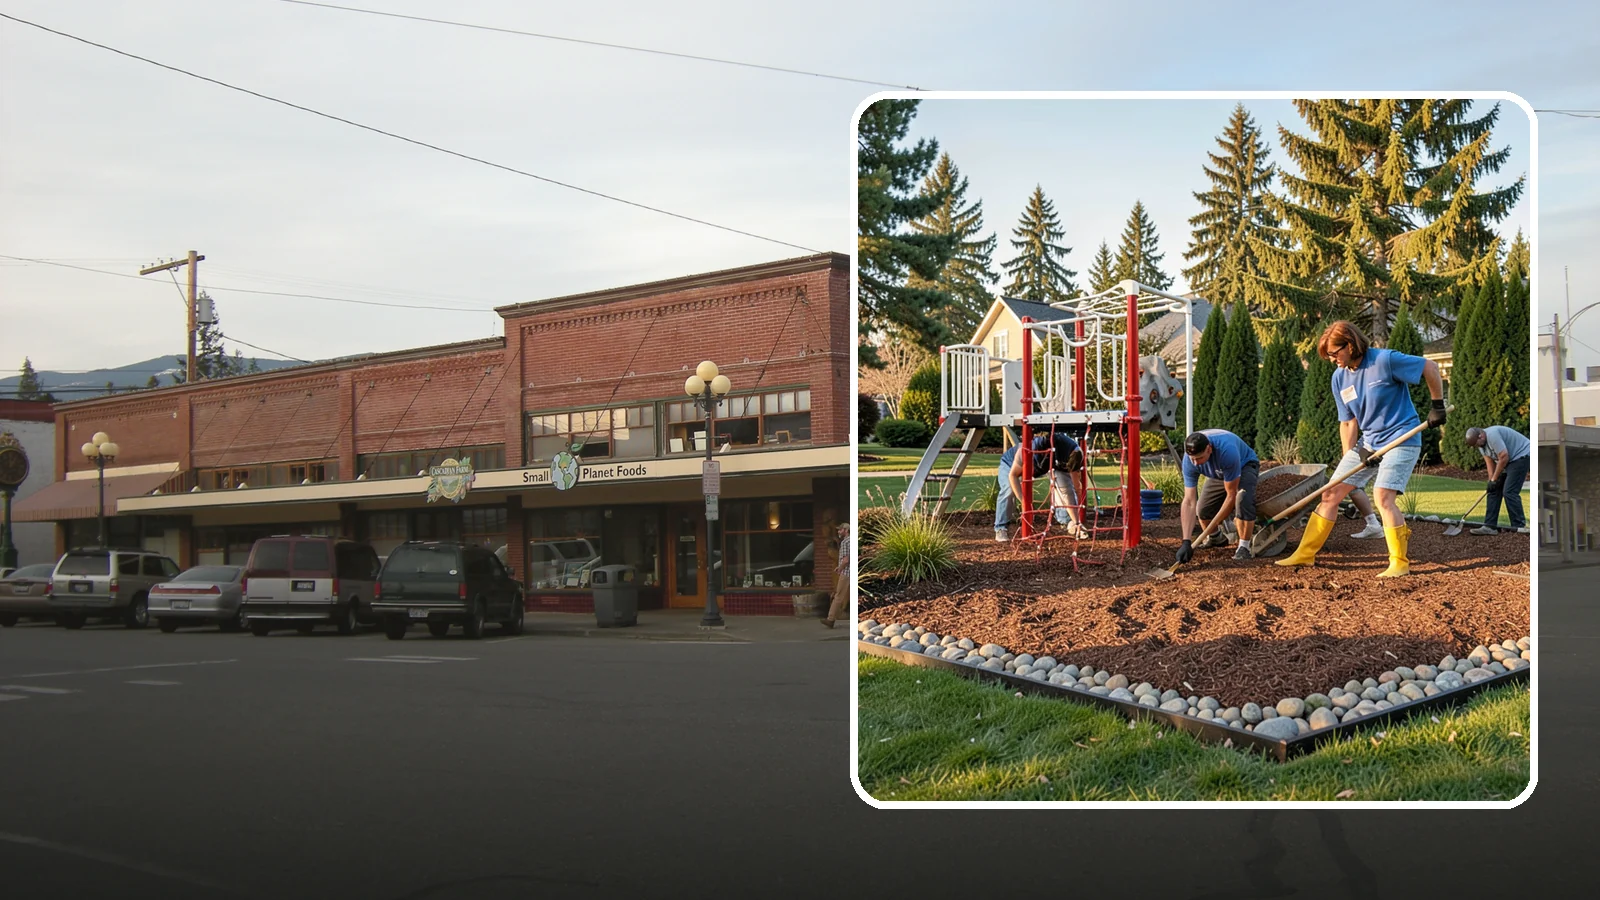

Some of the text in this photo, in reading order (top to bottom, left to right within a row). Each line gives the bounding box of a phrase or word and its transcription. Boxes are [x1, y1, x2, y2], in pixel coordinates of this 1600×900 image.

[523, 465, 647, 483] Small Planet Foods
